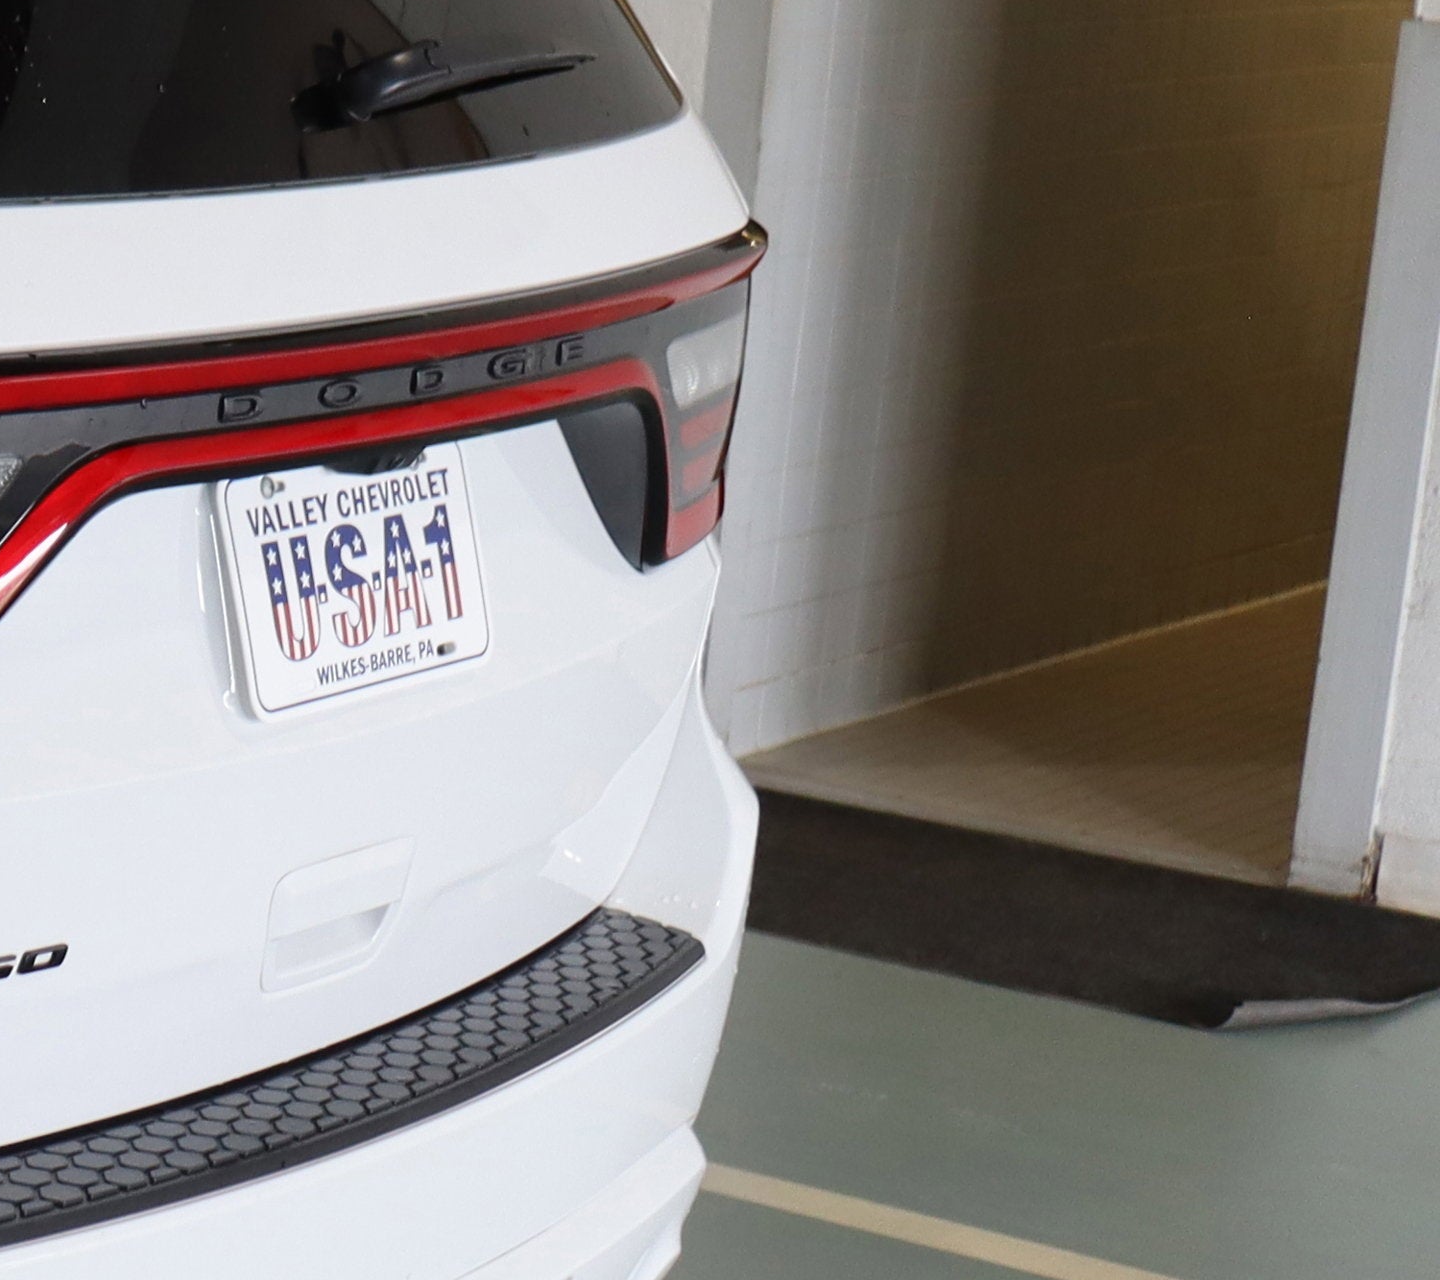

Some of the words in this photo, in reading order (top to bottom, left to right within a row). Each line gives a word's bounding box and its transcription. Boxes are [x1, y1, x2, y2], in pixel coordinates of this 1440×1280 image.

[216, 334, 584, 424] DODGE
[247, 493, 328, 537] VALLEY
[337, 468, 449, 518] CHEVROLET
[317, 647, 416, 685] WILKES-BARRE,
[418, 640, 434, 658] PA
